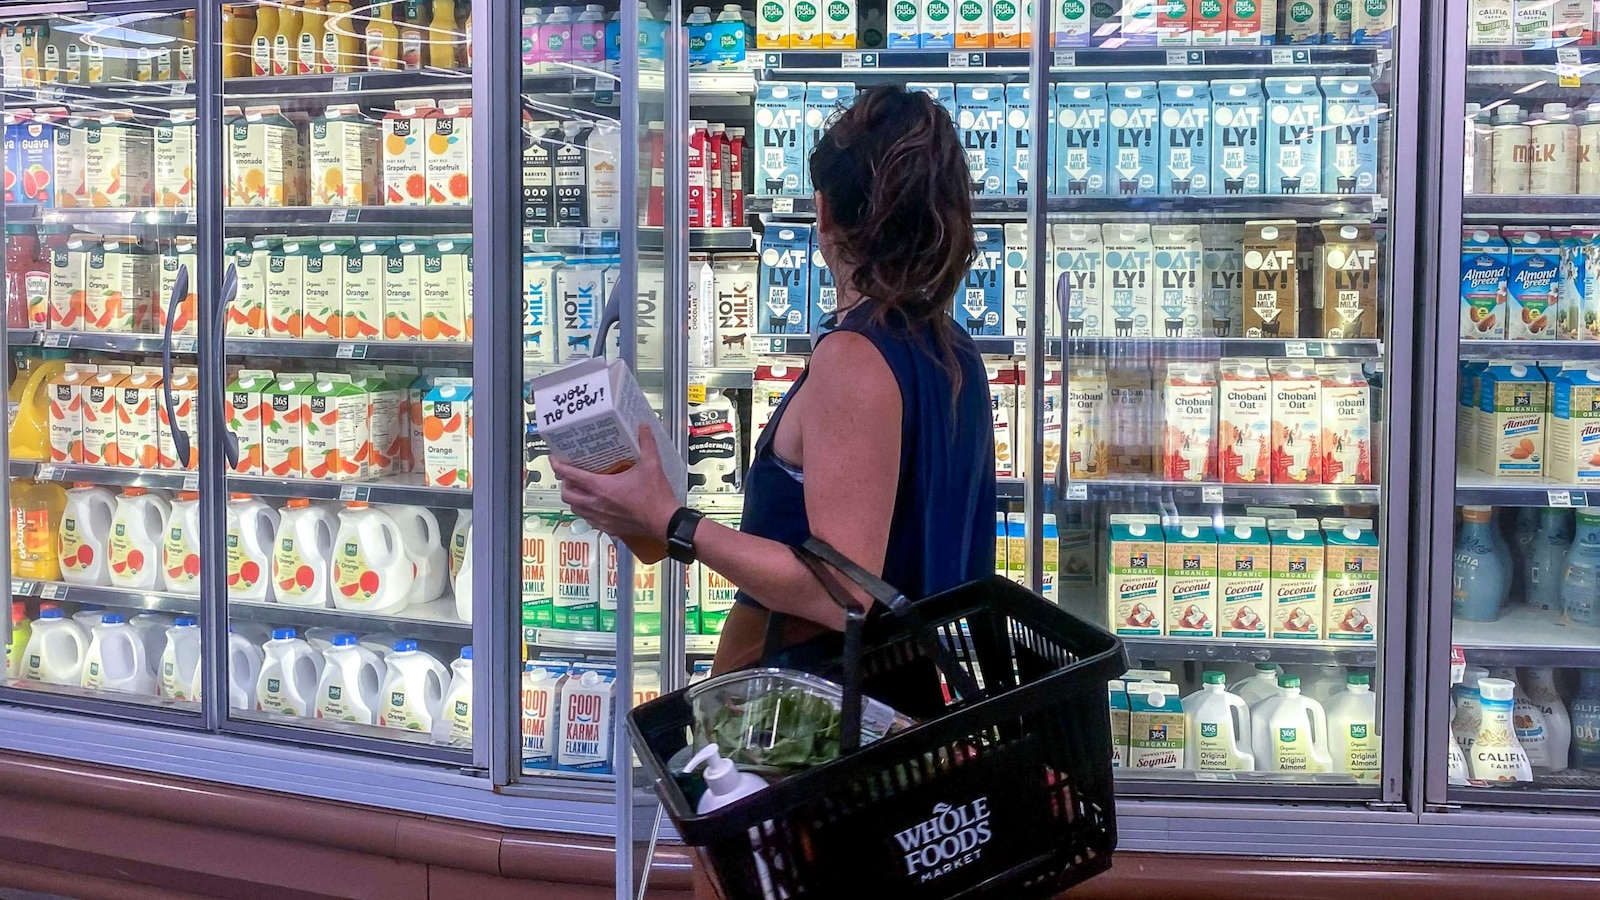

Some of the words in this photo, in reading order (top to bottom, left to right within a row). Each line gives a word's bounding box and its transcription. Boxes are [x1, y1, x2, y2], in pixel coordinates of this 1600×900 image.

[1065, 5, 1083, 15] pods
[1201, 4, 1220, 14] pods
[1236, 4, 1254, 14] pods
[1293, 8, 1311, 18] pods
[1367, 4, 1385, 12] pods
[764, 129, 796, 148] LY!
[965, 131, 998, 149] LY!
[1066, 129, 1100, 147] LY!
[1118, 128, 1151, 147] LY!
[1170, 128, 1204, 147] LY!
[1223, 128, 1257, 146] LY!
[22, 139, 49, 150] Guava
[233, 151, 251, 159] Ginger
[313, 150, 330, 158] Ginger
[386, 163, 417, 173] Grapefruit
[429, 163, 460, 172] Grapefruit
[1120, 160, 1137, 169] MILK
[271, 258, 284, 267] 365
[308, 258, 321, 267] 365
[348, 258, 361, 267] 365
[389, 258, 402, 267] 365
[426, 257, 440, 266] 365
[972, 251, 1002, 270] AT-
[770, 268, 800, 286] LY!
[1463, 266, 1505, 281] Almond
[1514, 267, 1557, 283] Almond
[965, 270, 996, 288] LY!
[1113, 271, 1145, 289] LY!
[1163, 271, 1195, 289] LY!
[1252, 271, 1287, 289] LY!
[1335, 271, 1369, 289] LY!
[1471, 278, 1499, 288] Breeze
[1523, 279, 1550, 289] Breeze
[306, 289, 328, 297] Orange
[346, 289, 369, 297] Orange
[387, 289, 411, 298] Orange
[425, 289, 449, 297] Orange
[529, 282, 543, 327] MILK
[578, 285, 593, 330] MILK
[719, 291, 733, 328] NOT
[734, 286, 748, 329] MILK
[564, 291, 578, 329] NOT
[553, 383, 589, 406] wow
[1228, 392, 1267, 401] Chobani
[1277, 392, 1317, 401] Chobani
[543, 409, 564, 425] no
[567, 387, 604, 415] cow!
[1077, 400, 1093, 409] Oat
[1175, 397, 1213, 407] Chobani
[1239, 400, 1256, 409] Oat
[1289, 400, 1306, 409] Oat
[1186, 405, 1203, 414] Oat
[1338, 407, 1355, 416] Oat
[701, 410, 719, 422] SO
[694, 418, 727, 427] DELICIOUS
[1502, 416, 1541, 430] Almond
[52, 425, 72, 433] Orange
[85, 427, 104, 436] Orange
[119, 429, 139, 437] Orange
[267, 436, 289, 446] Orange
[428, 446, 452, 455] Orange
[689, 440, 733, 453] Wondermilk
[522, 539, 544, 564] OOD
[559, 541, 589, 567] GOOD
[1132, 558, 1146, 567] 365
[1184, 560, 1199, 568] 365
[1237, 561, 1252, 569] 365
[1291, 562, 1305, 571] 365
[559, 568, 589, 584] KARMA
[559, 584, 589, 597] FLAXMILK
[1120, 579, 1158, 593] Coconut
[1172, 581, 1211, 595] Coconut
[1225, 582, 1264, 596] Coconut
[1277, 584, 1317, 597] Coconut
[1333, 584, 1372, 598] Coconut
[568, 693, 601, 723] GOOD
[566, 722, 599, 741] KARMA
[1202, 724, 1217, 733] 365
[1281, 729, 1295, 738] 365
[1151, 731, 1165, 740] 365
[565, 741, 599, 755] FLAXMILK
[1200, 752, 1227, 760] Original
[1280, 757, 1307, 765] Original
[1350, 753, 1377, 761] Original
[1136, 755, 1177, 769] Soymilk
[1200, 759, 1227, 767] Almond
[1280, 763, 1306, 771] Almond
[1351, 759, 1377, 767] Almond
[894, 796, 991, 853] WHOLE
[904, 820, 992, 876] FOODS
[920, 848, 982, 883] MARKET
